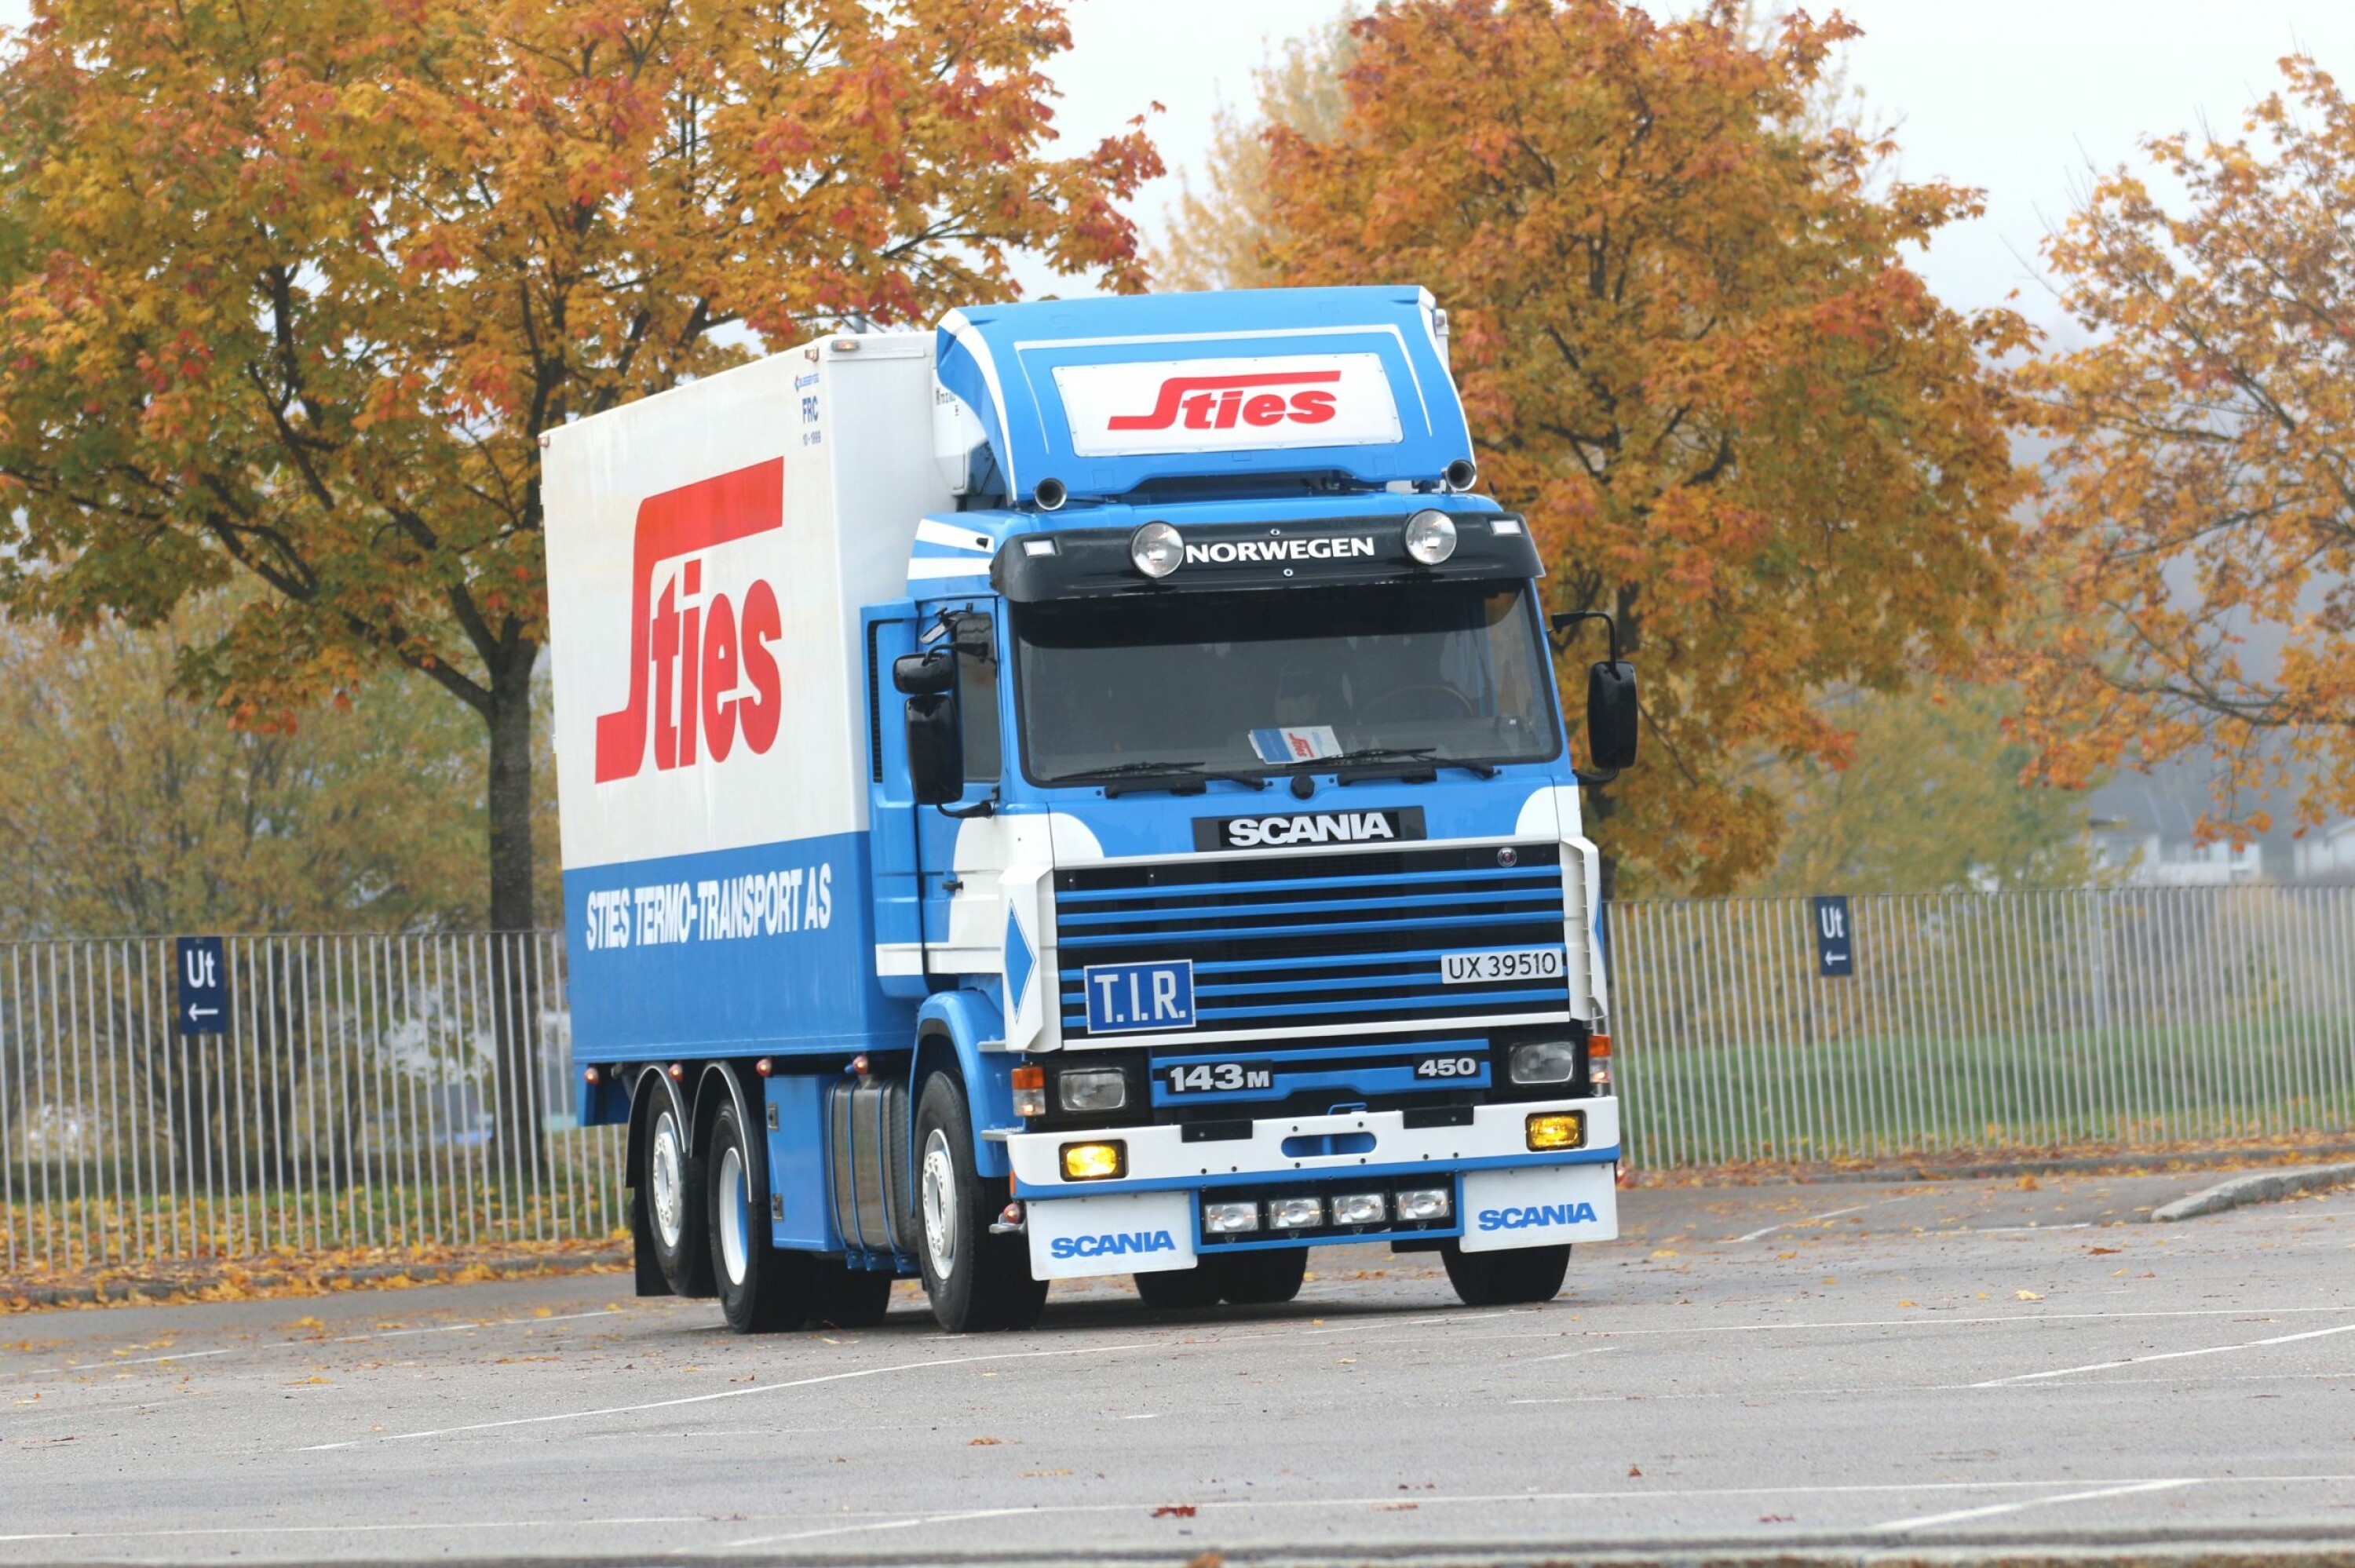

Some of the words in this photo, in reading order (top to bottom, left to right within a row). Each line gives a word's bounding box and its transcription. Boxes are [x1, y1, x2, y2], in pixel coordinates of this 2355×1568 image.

[801, 396, 819, 424] FRC
[1108, 370, 1342, 431] Sties
[1185, 537, 1375, 564] NORWEGEN
[595, 456, 784, 783] Sties
[1229, 811, 1394, 847] SCANIA
[586, 888, 630, 950] STIES
[634, 868, 802, 946] TERMO-TRANSPORT
[805, 862, 831, 930] AS
[1821, 907, 1845, 939] Ut
[186, 950, 216, 988] Ut
[1448, 957, 1481, 979] UX
[1488, 952, 1556, 977] 39510
[1094, 970, 1186, 1023] T.I.R.
[1418, 1058, 1477, 1077] 450
[1478, 1202, 1597, 1231] SCANIA
[1051, 1231, 1176, 1260] SCANIA
